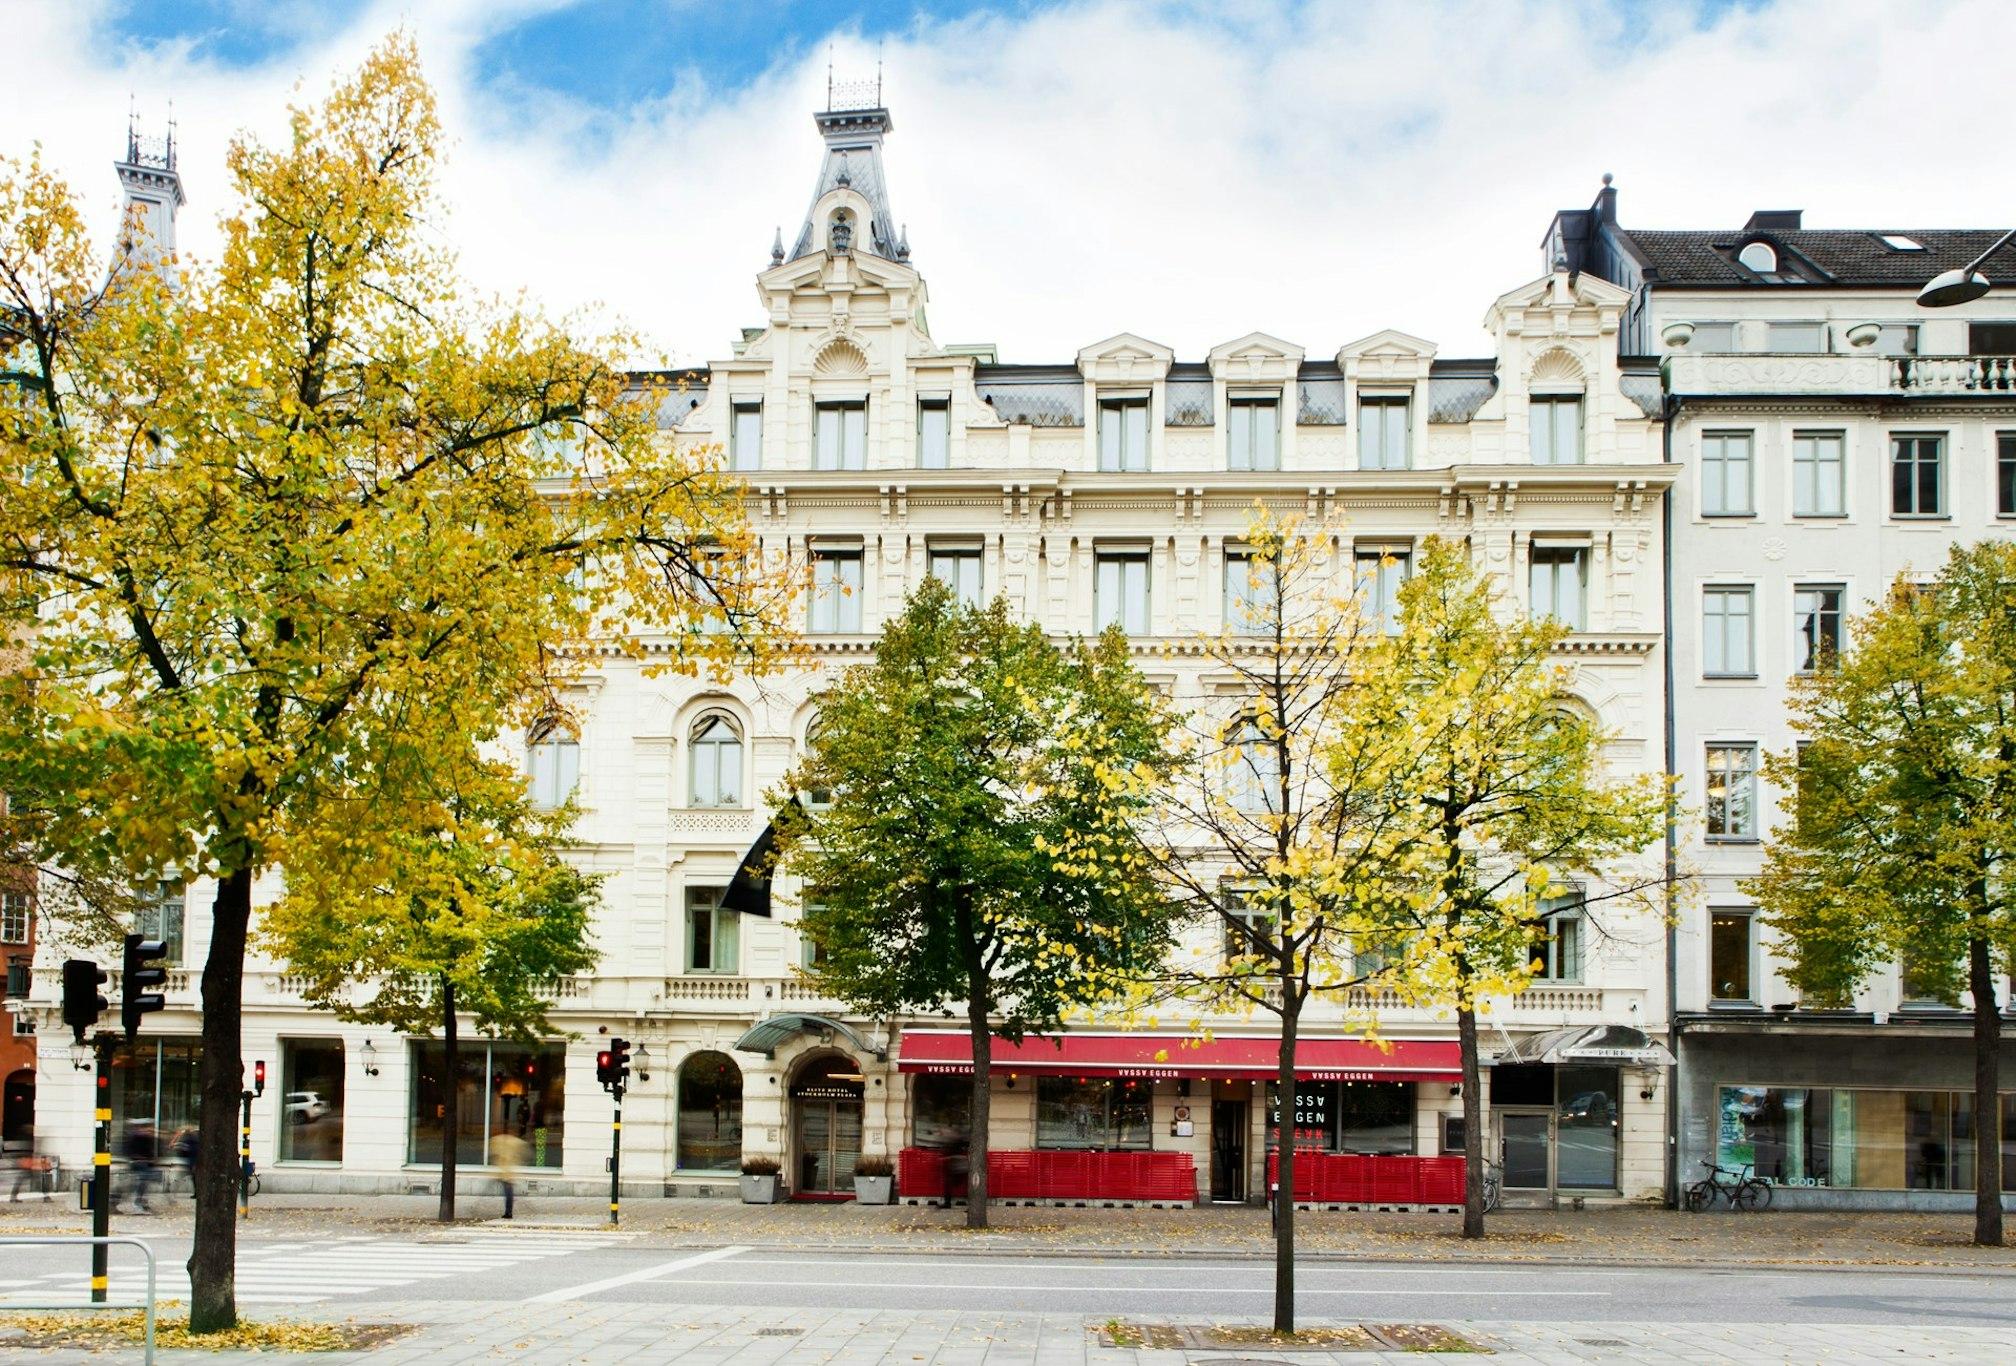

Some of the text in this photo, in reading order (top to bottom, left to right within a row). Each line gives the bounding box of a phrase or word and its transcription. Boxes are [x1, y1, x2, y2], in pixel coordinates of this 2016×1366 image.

[1344, 1072, 1374, 1080] EGGEN
[1274, 1095, 1325, 1107] VSSA
[1273, 1111, 1325, 1123] EGEN
[1272, 1127, 1324, 1140] SEAK
[1788, 1177, 1826, 1188] CODE
